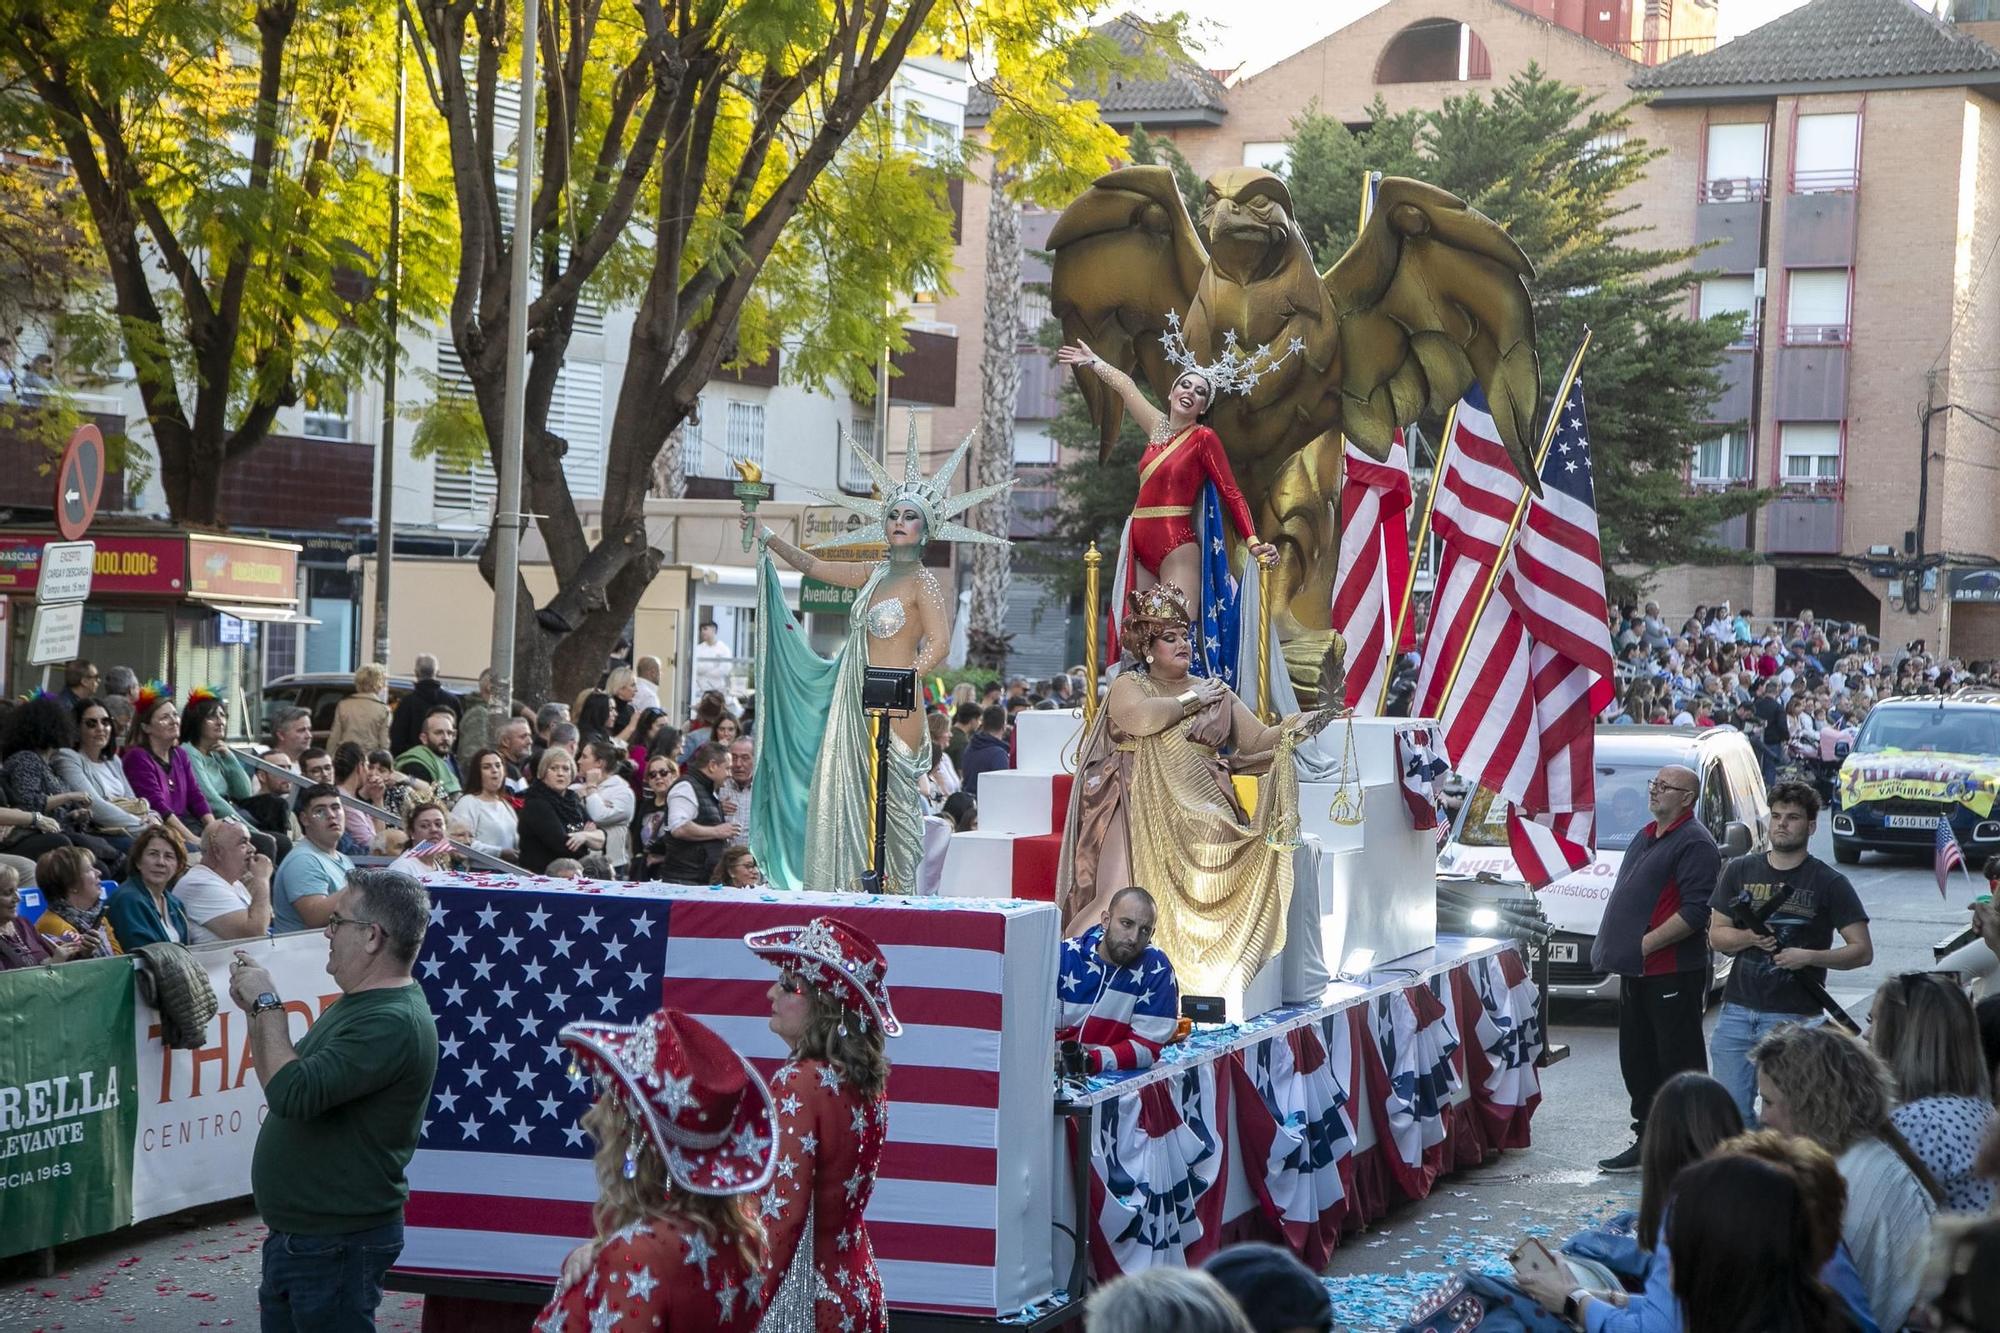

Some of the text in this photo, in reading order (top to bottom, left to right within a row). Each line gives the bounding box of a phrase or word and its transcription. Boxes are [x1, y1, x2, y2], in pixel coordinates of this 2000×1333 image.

[803, 586, 839, 603] Avenida
[841, 587, 854, 603] de
[1892, 816, 1917, 826] 4910
[1456, 858, 1521, 874] NUEV
[142, 1110, 242, 1151] CENTRO
[37, 1162, 73, 1180] 1963
